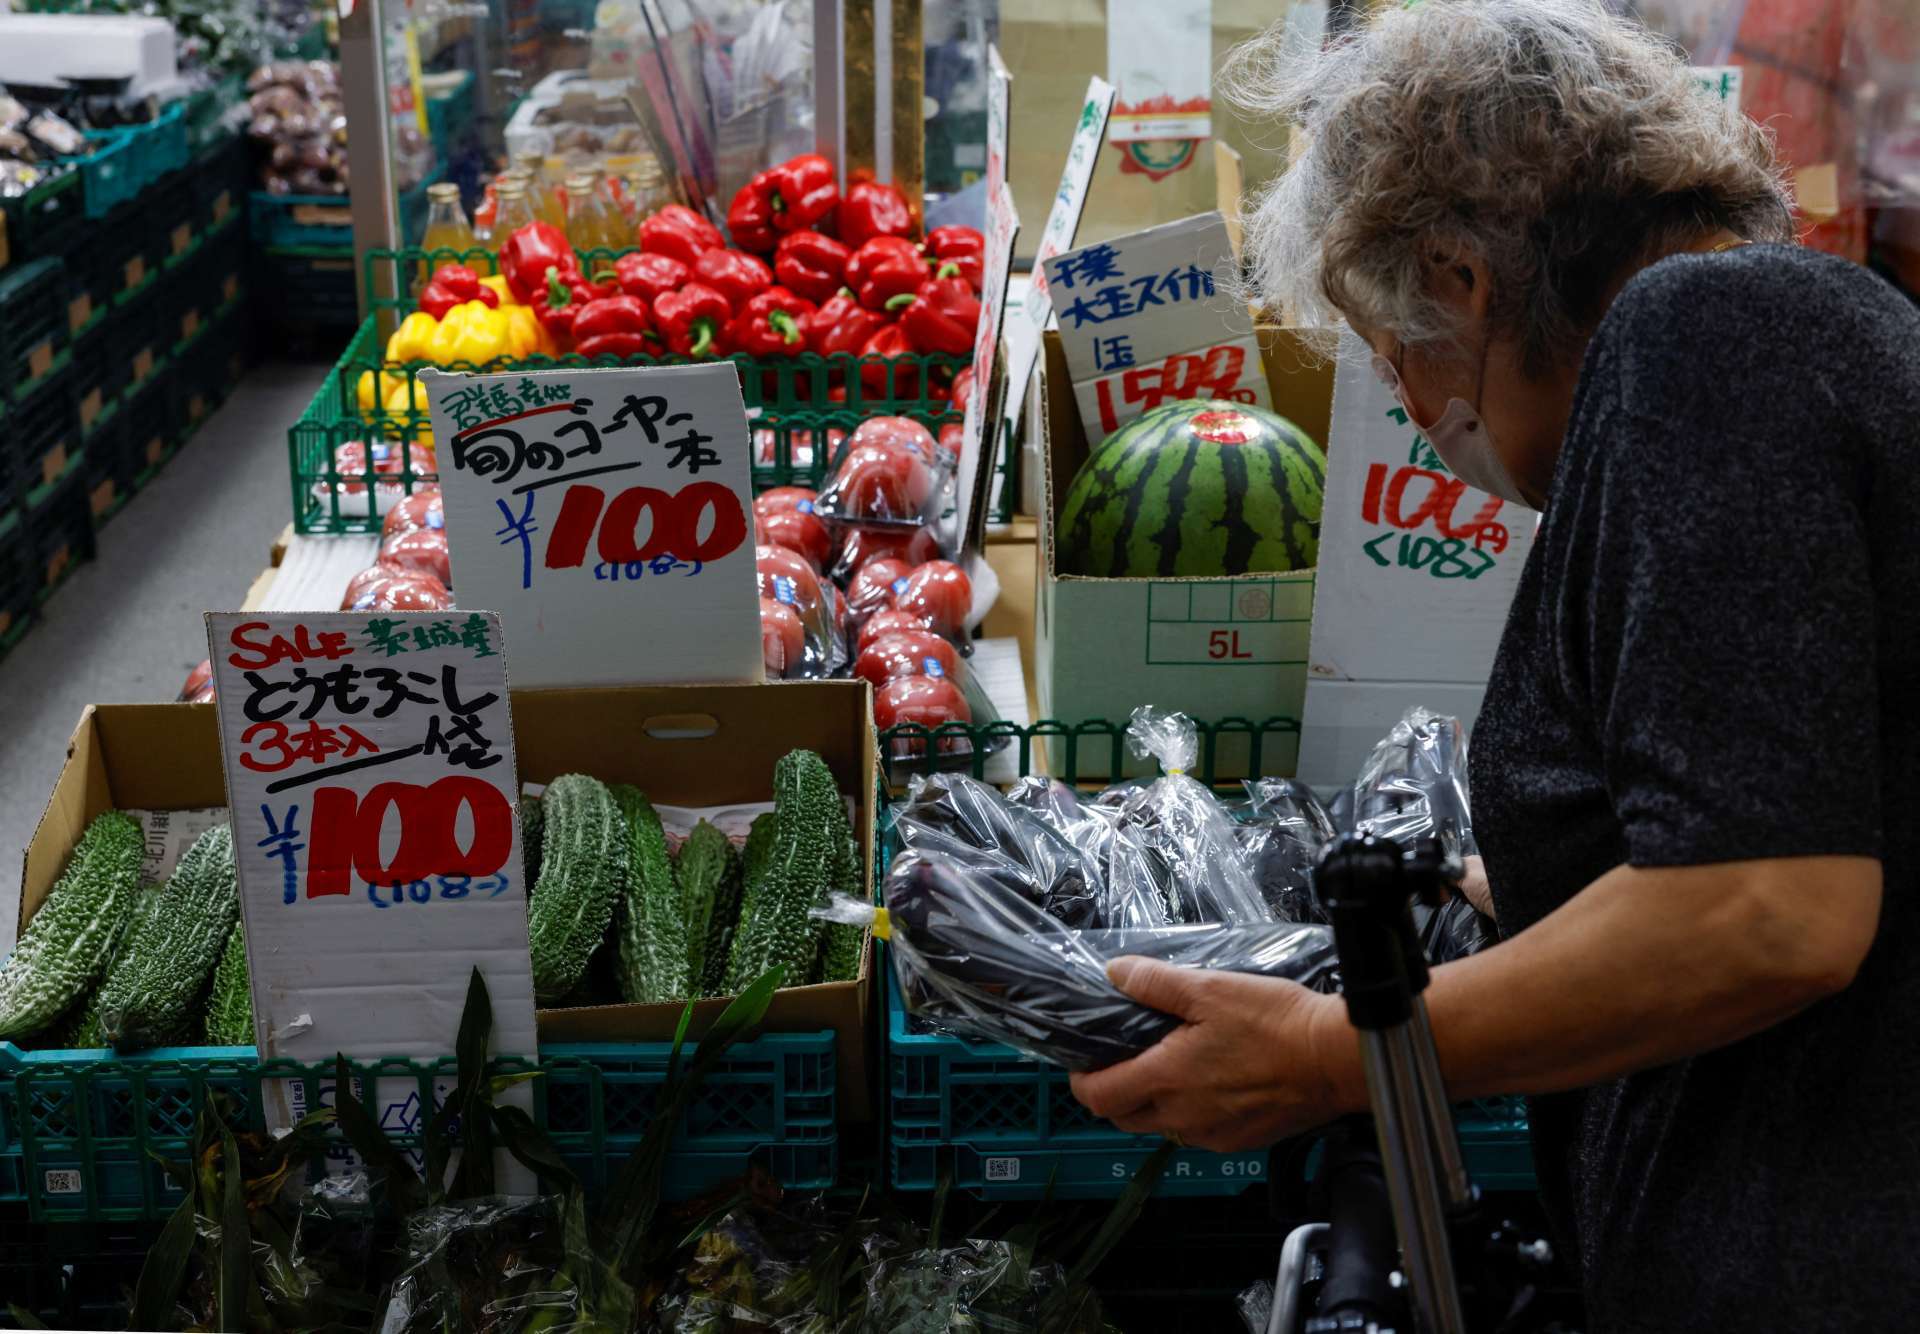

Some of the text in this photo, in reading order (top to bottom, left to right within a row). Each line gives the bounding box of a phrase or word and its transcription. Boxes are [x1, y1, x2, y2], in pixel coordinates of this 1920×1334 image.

[1051, 244, 1124, 287] 千葉
[229, 613, 499, 670] SALE 茨城産
[1207, 630, 1252, 660] 5L
[243, 664, 500, 722] とうもろこし
[240, 720, 380, 772] 3本入
[1111, 1160, 1262, 1178] S..R. 610
